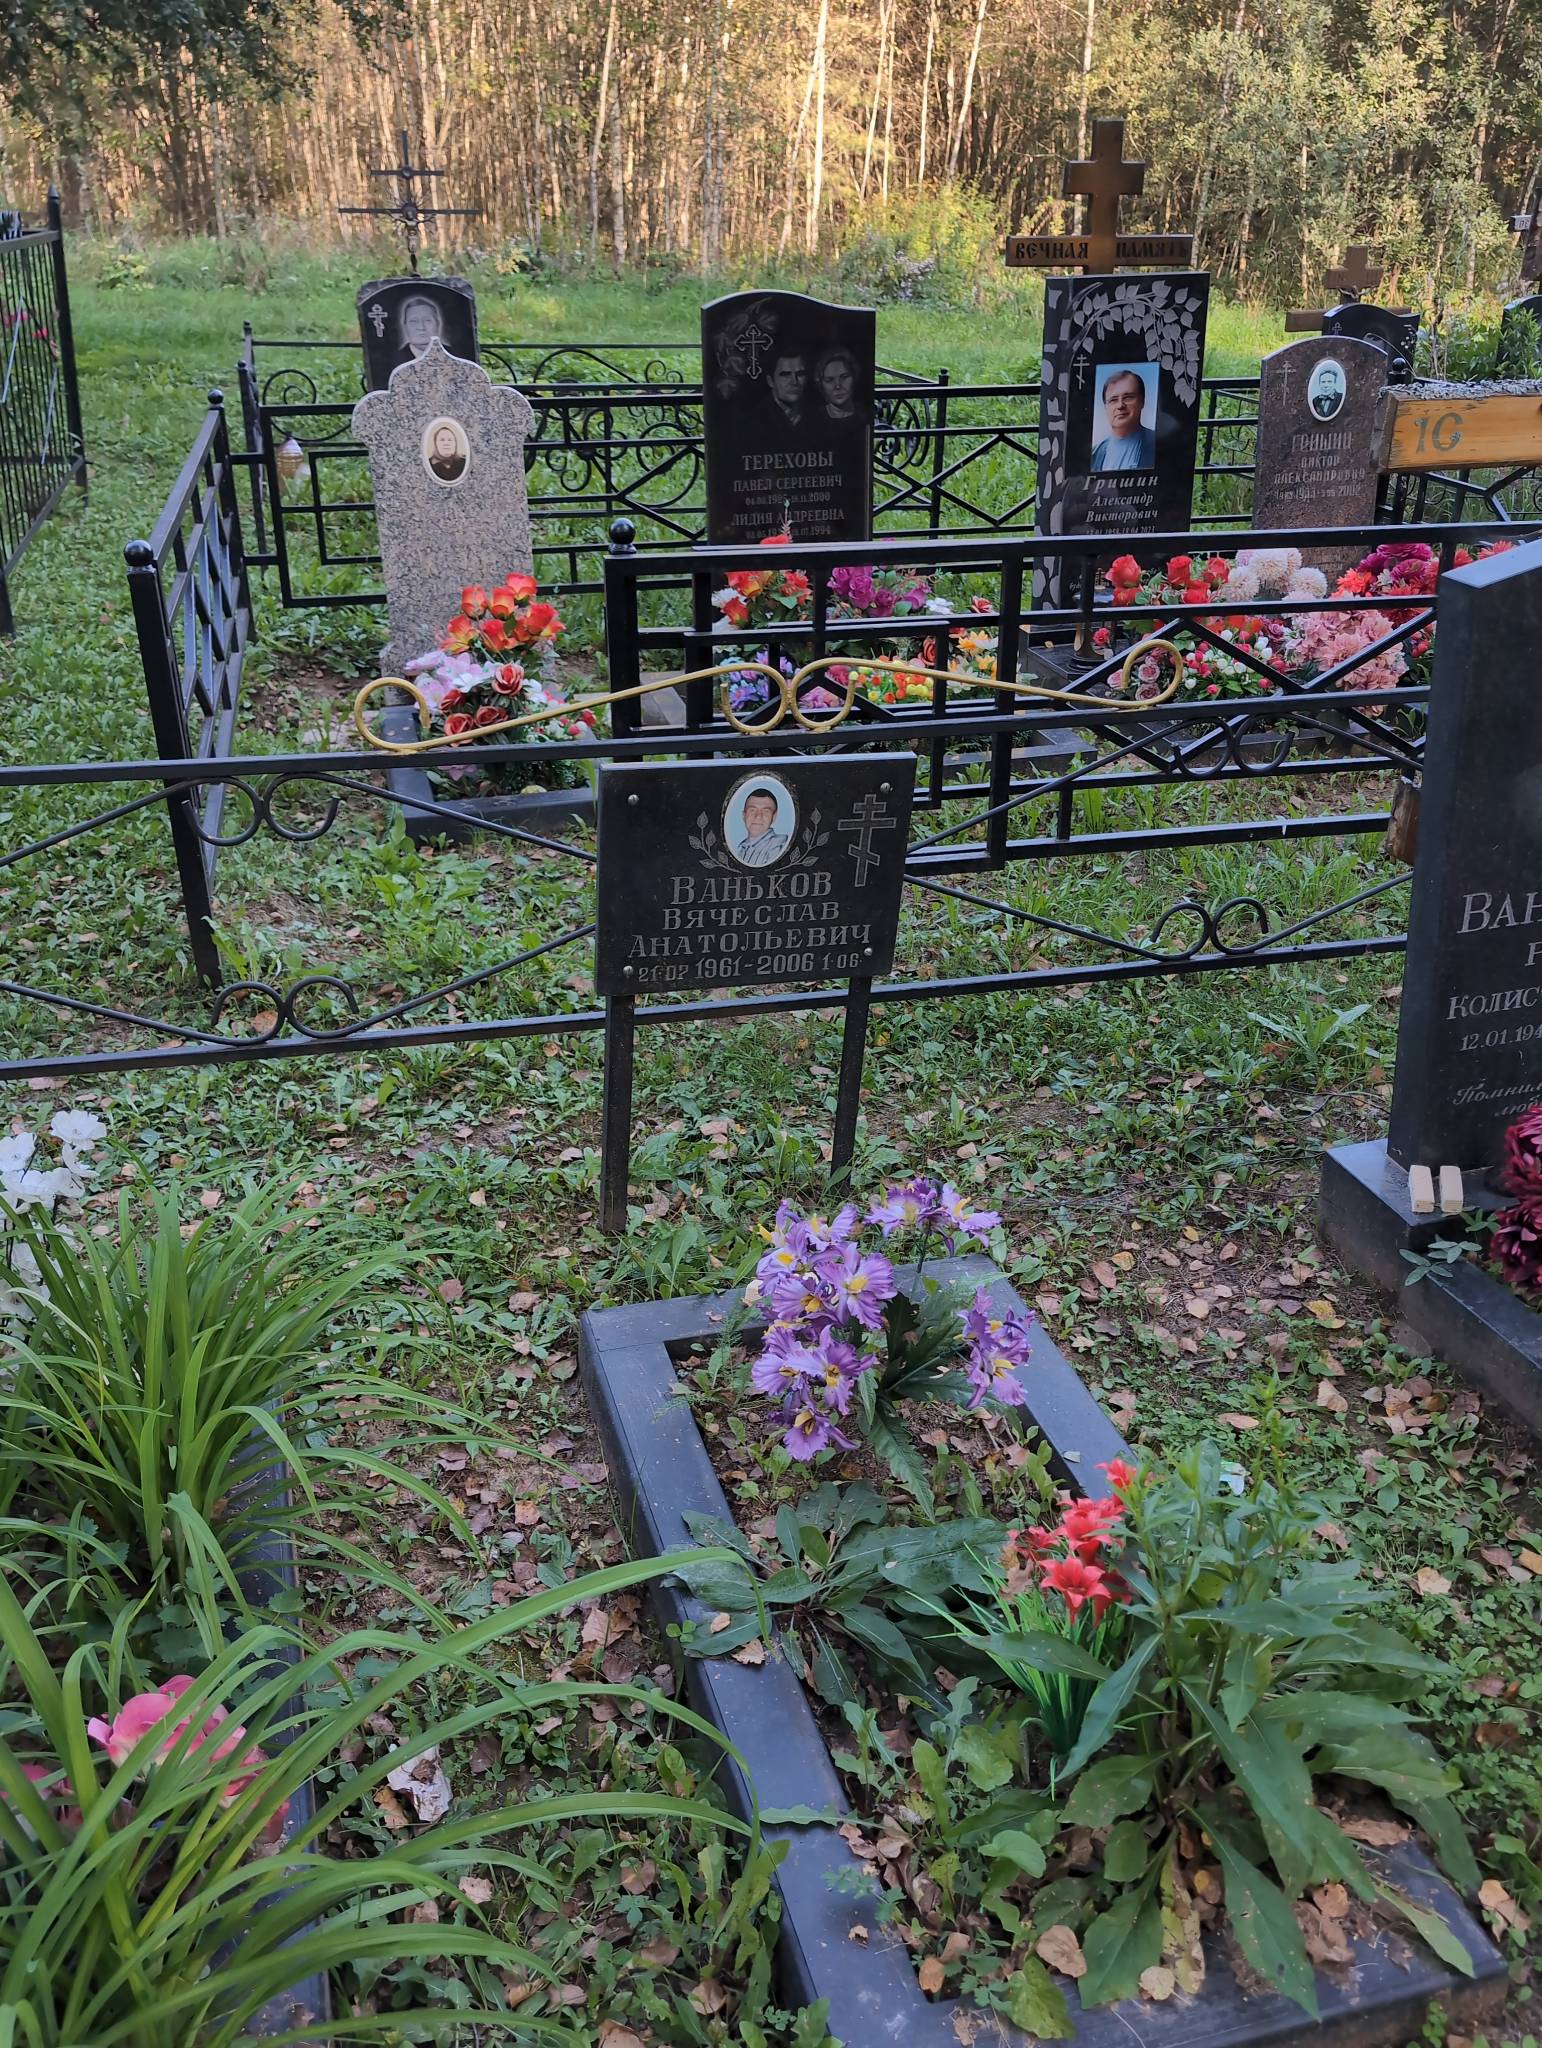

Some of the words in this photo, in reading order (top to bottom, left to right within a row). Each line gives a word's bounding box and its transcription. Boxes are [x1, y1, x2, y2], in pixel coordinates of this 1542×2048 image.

[1015, 242, 1088, 259] ВЕЧНАЯ
[742, 451, 834, 470] ТЕРЕХОВЫ
[733, 479, 772, 492] ПАВЕЛ
[776, 474, 843, 491] СЕРГЕЕВИЧ
[1082, 475, 1159, 494] Гришин
[1092, 493, 1154, 507] Александр
[731, 512, 773, 527] ЛИДИЯ
[1085, 508, 1159, 524] Викторович
[670, 871, 833, 905] ВАНЬКОВ
[661, 901, 840, 930] ВЯЧЕСЛАВ
[628, 924, 871, 958] АНАТОЛЬЕВИЧ
[1446, 986, 1542, 1020] КОЛИС
